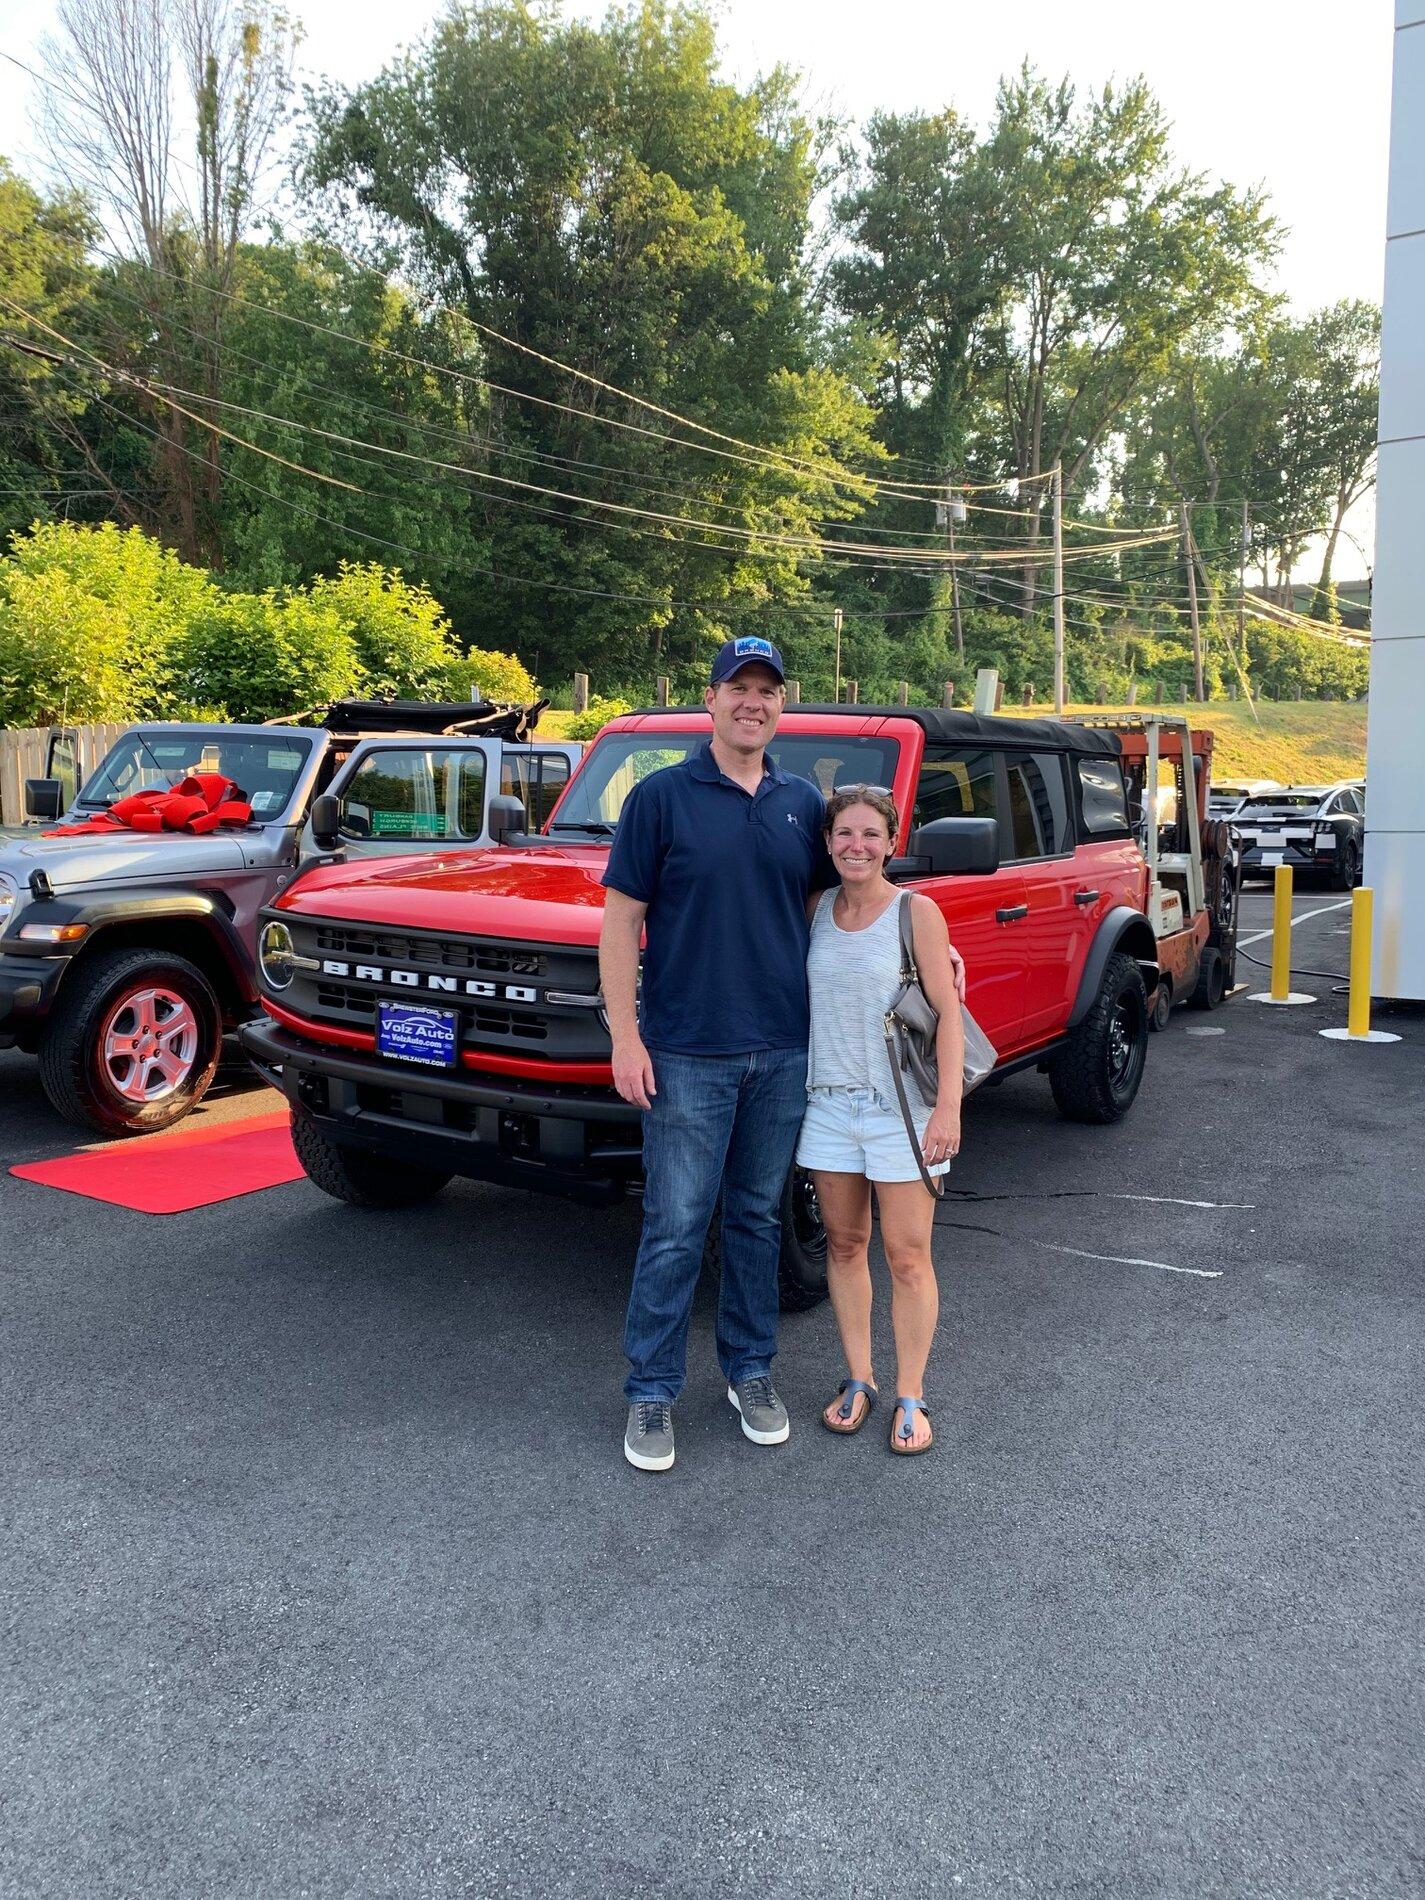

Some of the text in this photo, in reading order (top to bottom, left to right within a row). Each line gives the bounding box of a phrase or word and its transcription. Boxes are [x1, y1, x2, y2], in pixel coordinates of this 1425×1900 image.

[322, 960, 537, 1002] BRONCO
[381, 1020, 454, 1041] Volz Auto
[391, 1033, 442, 1049] VolzAuto.com
